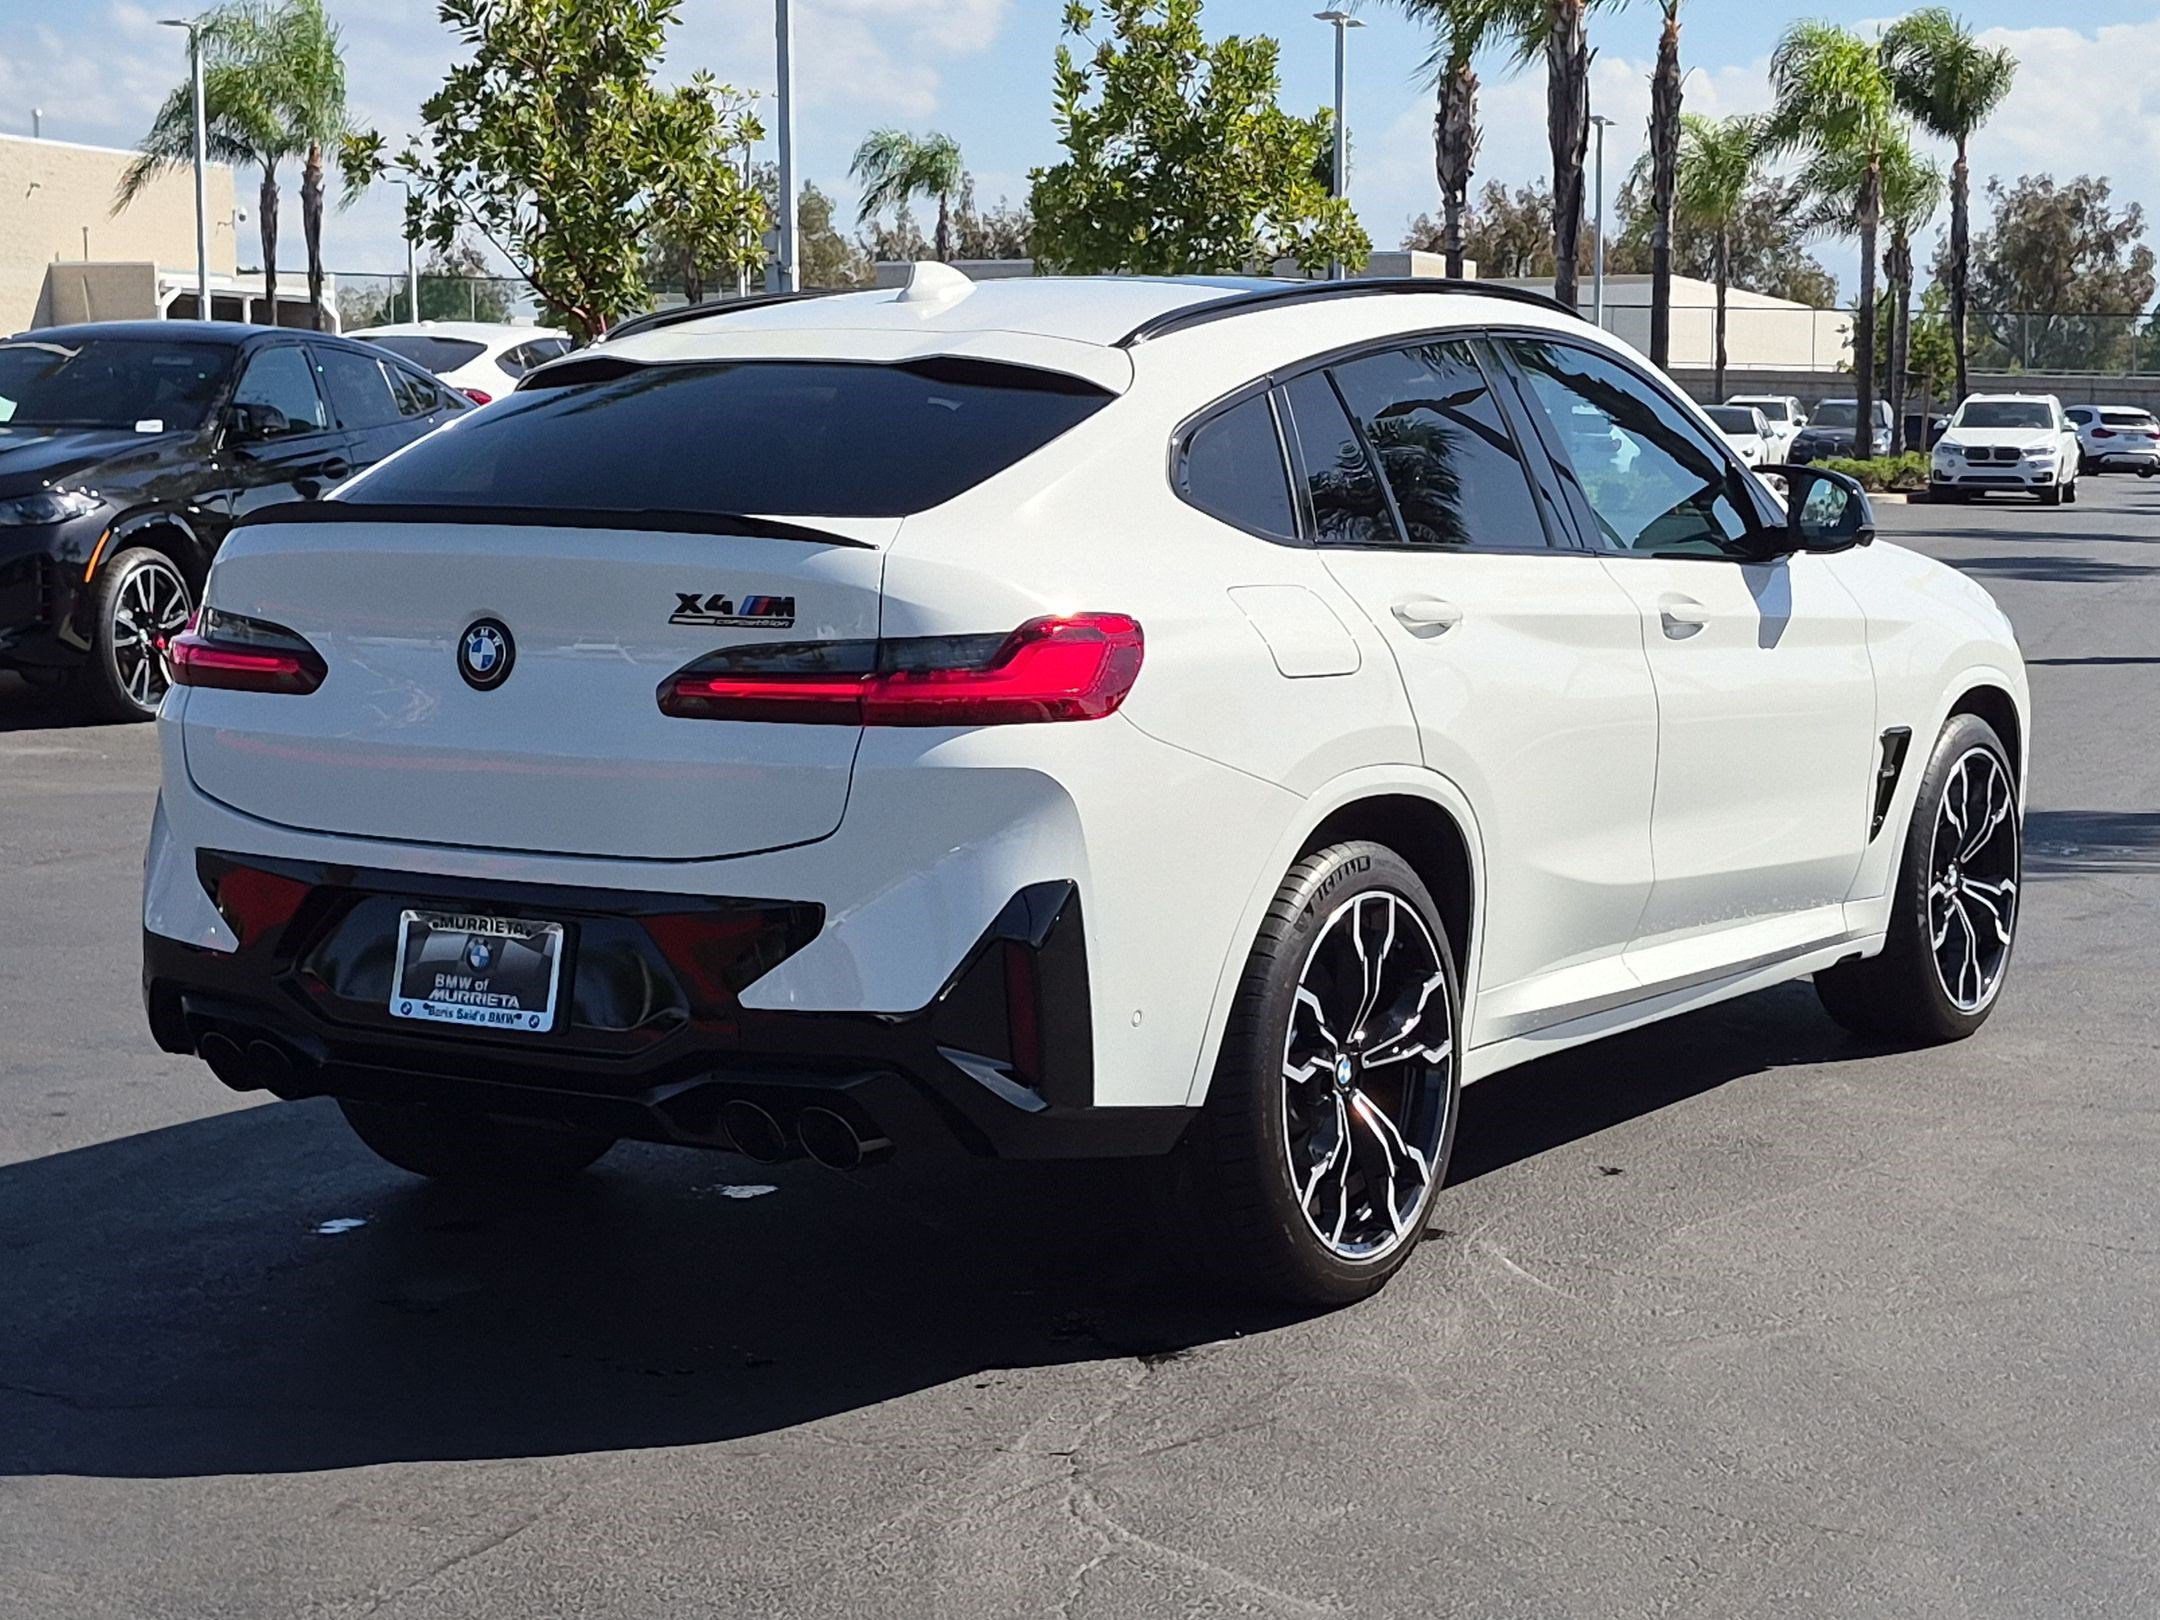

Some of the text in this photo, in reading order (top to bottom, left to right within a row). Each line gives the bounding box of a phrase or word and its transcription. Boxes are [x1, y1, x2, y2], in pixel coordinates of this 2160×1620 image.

[674, 593, 733, 615] X4
[440, 917, 523, 934] MURRIETA
[435, 973, 490, 991] BMW of
[428, 989, 520, 1009] MURRIETA
[488, 1011, 516, 1024] BMW
